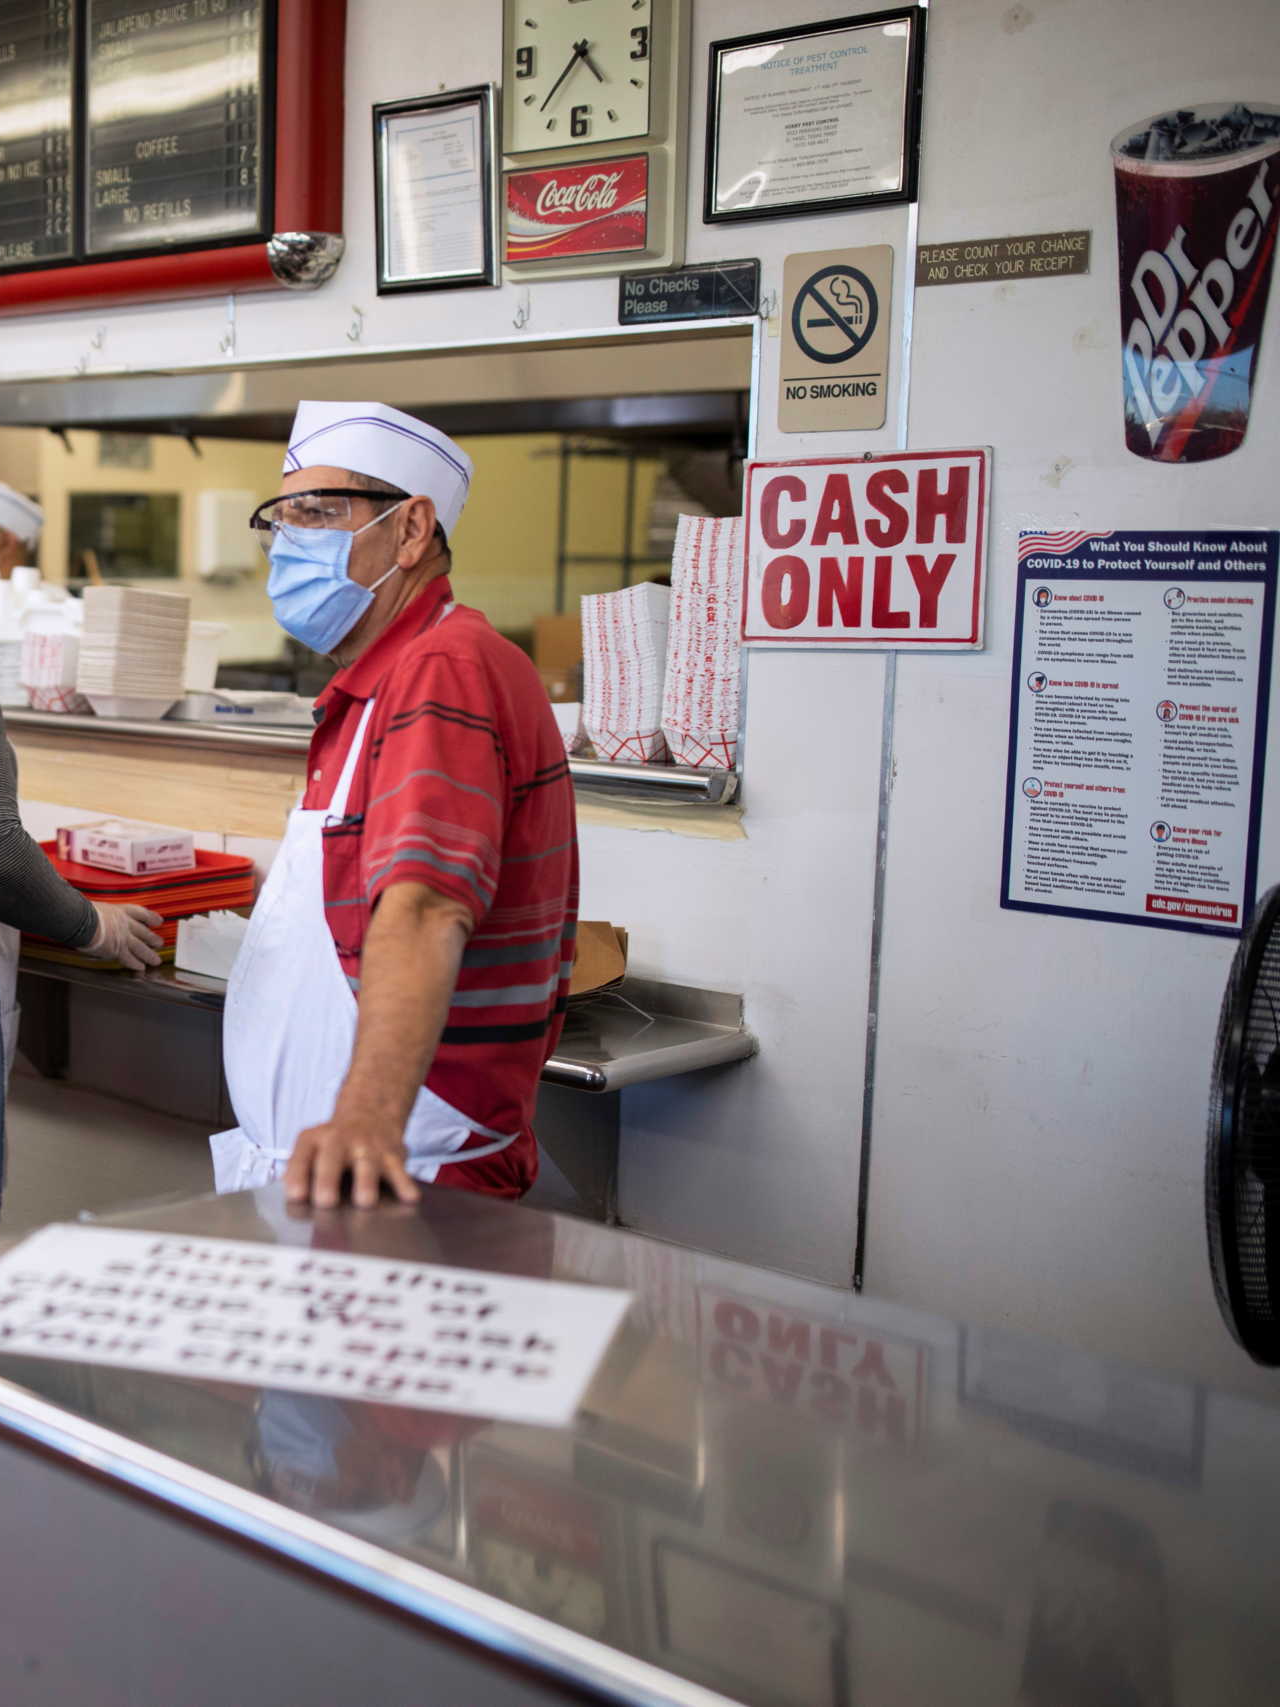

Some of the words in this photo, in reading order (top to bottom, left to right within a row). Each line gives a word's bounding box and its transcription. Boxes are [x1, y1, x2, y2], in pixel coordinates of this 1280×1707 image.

[630, 26, 648, 60] 3
[807, 52, 827, 63] PEST
[830, 46, 867, 60] CONTROL
[516, 46, 533, 79] 9
[789, 62, 839, 76] TREATMENT
[570, 105, 588, 138] 6
[135, 135, 179, 160] COFFEE
[95, 168, 133, 188] SMALL
[95, 187, 131, 208] LARGE
[123, 204, 140, 224] NO
[143, 198, 192, 221] REFILLS
[920, 248, 960, 264] PLEASE
[964, 244, 999, 260] COUNT
[1006, 241, 1036, 256] YOUR
[1041, 236, 1087, 253] CHANGE
[928, 266, 949, 280] AND
[954, 263, 988, 278] CHECK
[995, 260, 1024, 274] YOUR
[1030, 255, 1075, 272] RECEIPT
[624, 279, 645, 297] No
[648, 277, 700, 295] Checks
[624, 299, 668, 315] Please
[786, 385, 807, 400] NO
[809, 382, 877, 399] SMOKING
[760, 466, 970, 550] CASH
[1089, 541, 1117, 552] What
[1120, 541, 1145, 553] You
[1147, 541, 1191, 553] Should
[1193, 541, 1228, 553] Know
[1230, 542, 1268, 553] About
[1026, 559, 1080, 570] COVID-19
[1082, 559, 1095, 570] to
[1097, 559, 1142, 570] Protect
[1144, 559, 1195, 571] Yourself
[1197, 560, 1221, 571] and
[1223, 560, 1267, 571] Others
[761, 553, 958, 630] ONLY
[1151, 898, 1233, 918] cdc.gov/coronavirus
[298, 1256, 358, 1280] to
[384, 1266, 487, 1296] the
[105, 1256, 399, 1309] shortage
[429, 1296, 501, 1322] of
[40, 1300, 162, 1331] you
